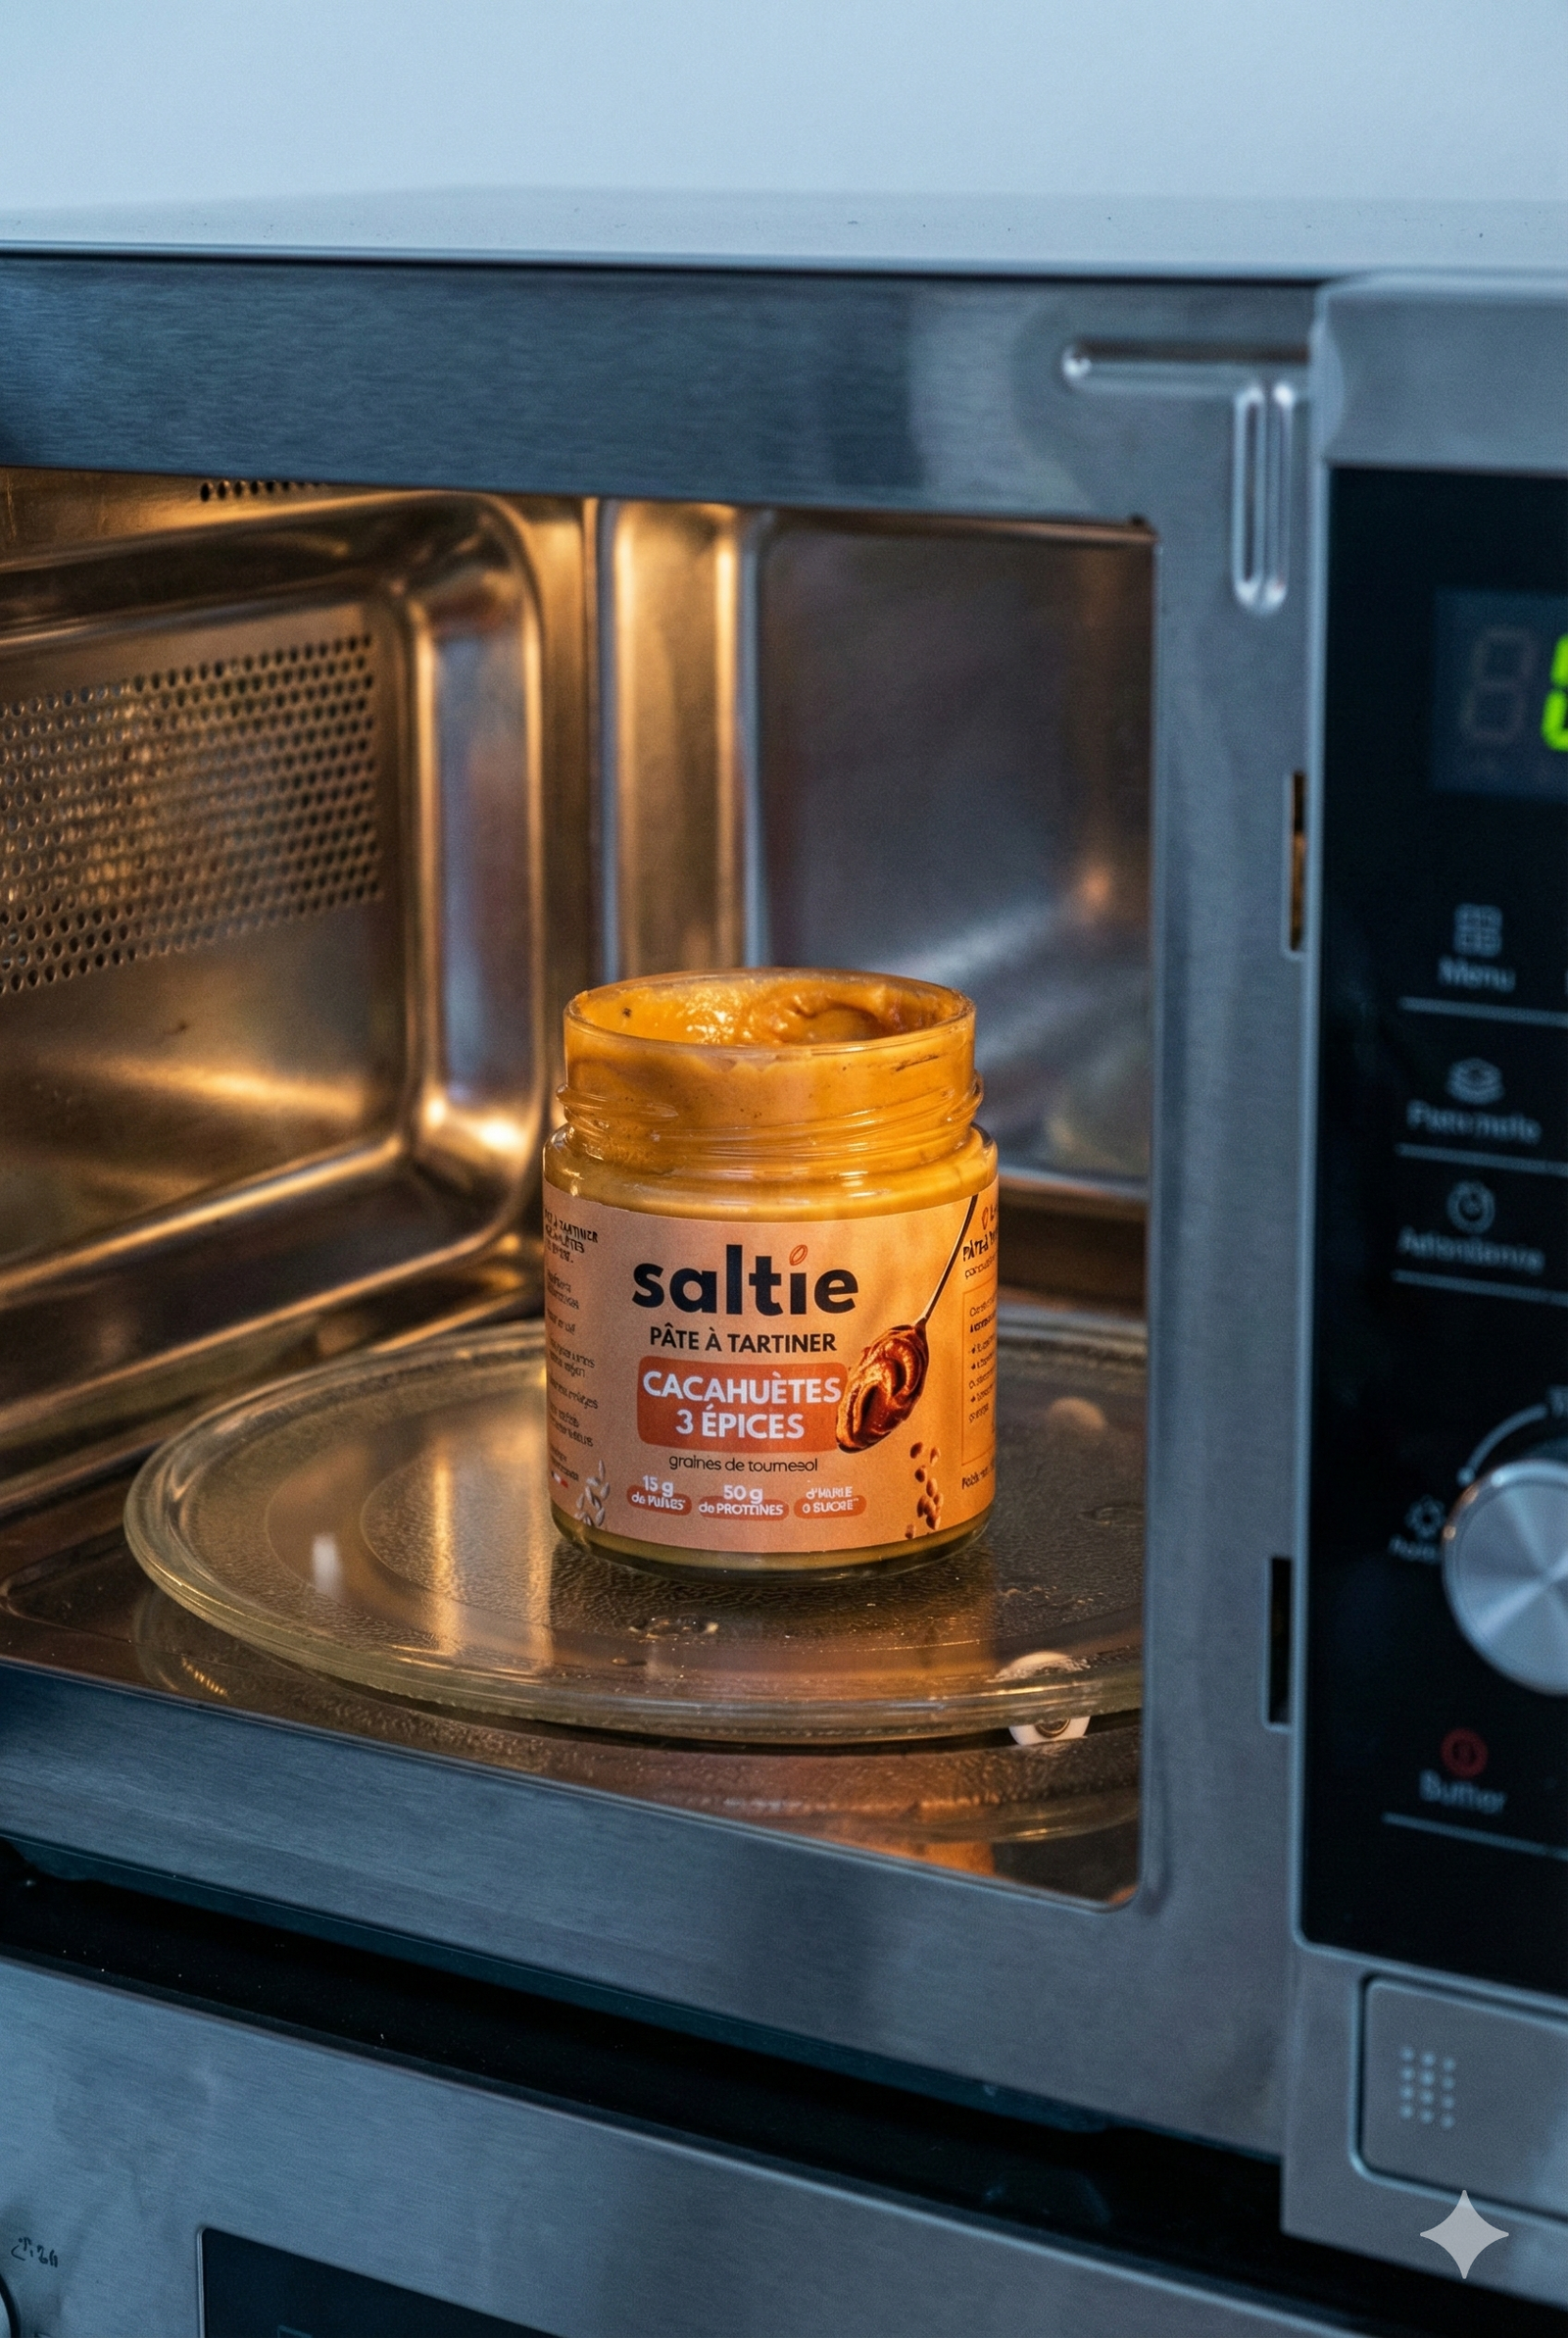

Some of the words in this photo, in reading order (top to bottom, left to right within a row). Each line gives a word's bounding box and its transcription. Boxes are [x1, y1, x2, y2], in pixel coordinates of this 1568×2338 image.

[631, 1244, 858, 1317] saltie
[650, 1322, 699, 1350] PÂTE
[705, 1326, 722, 1352] À
[727, 1333, 837, 1353] TARTINER
[642, 1370, 842, 1405] CACAHUÈTES
[675, 1410, 694, 1435] 3
[702, 1403, 805, 1439] ÉPICES
[668, 1455, 721, 1470] graines
[724, 1458, 745, 1471] de
[643, 1474, 659, 1492] 15
[662, 1481, 674, 1498] g
[723, 1484, 747, 1501] 50
[749, 1487, 763, 1505] g
